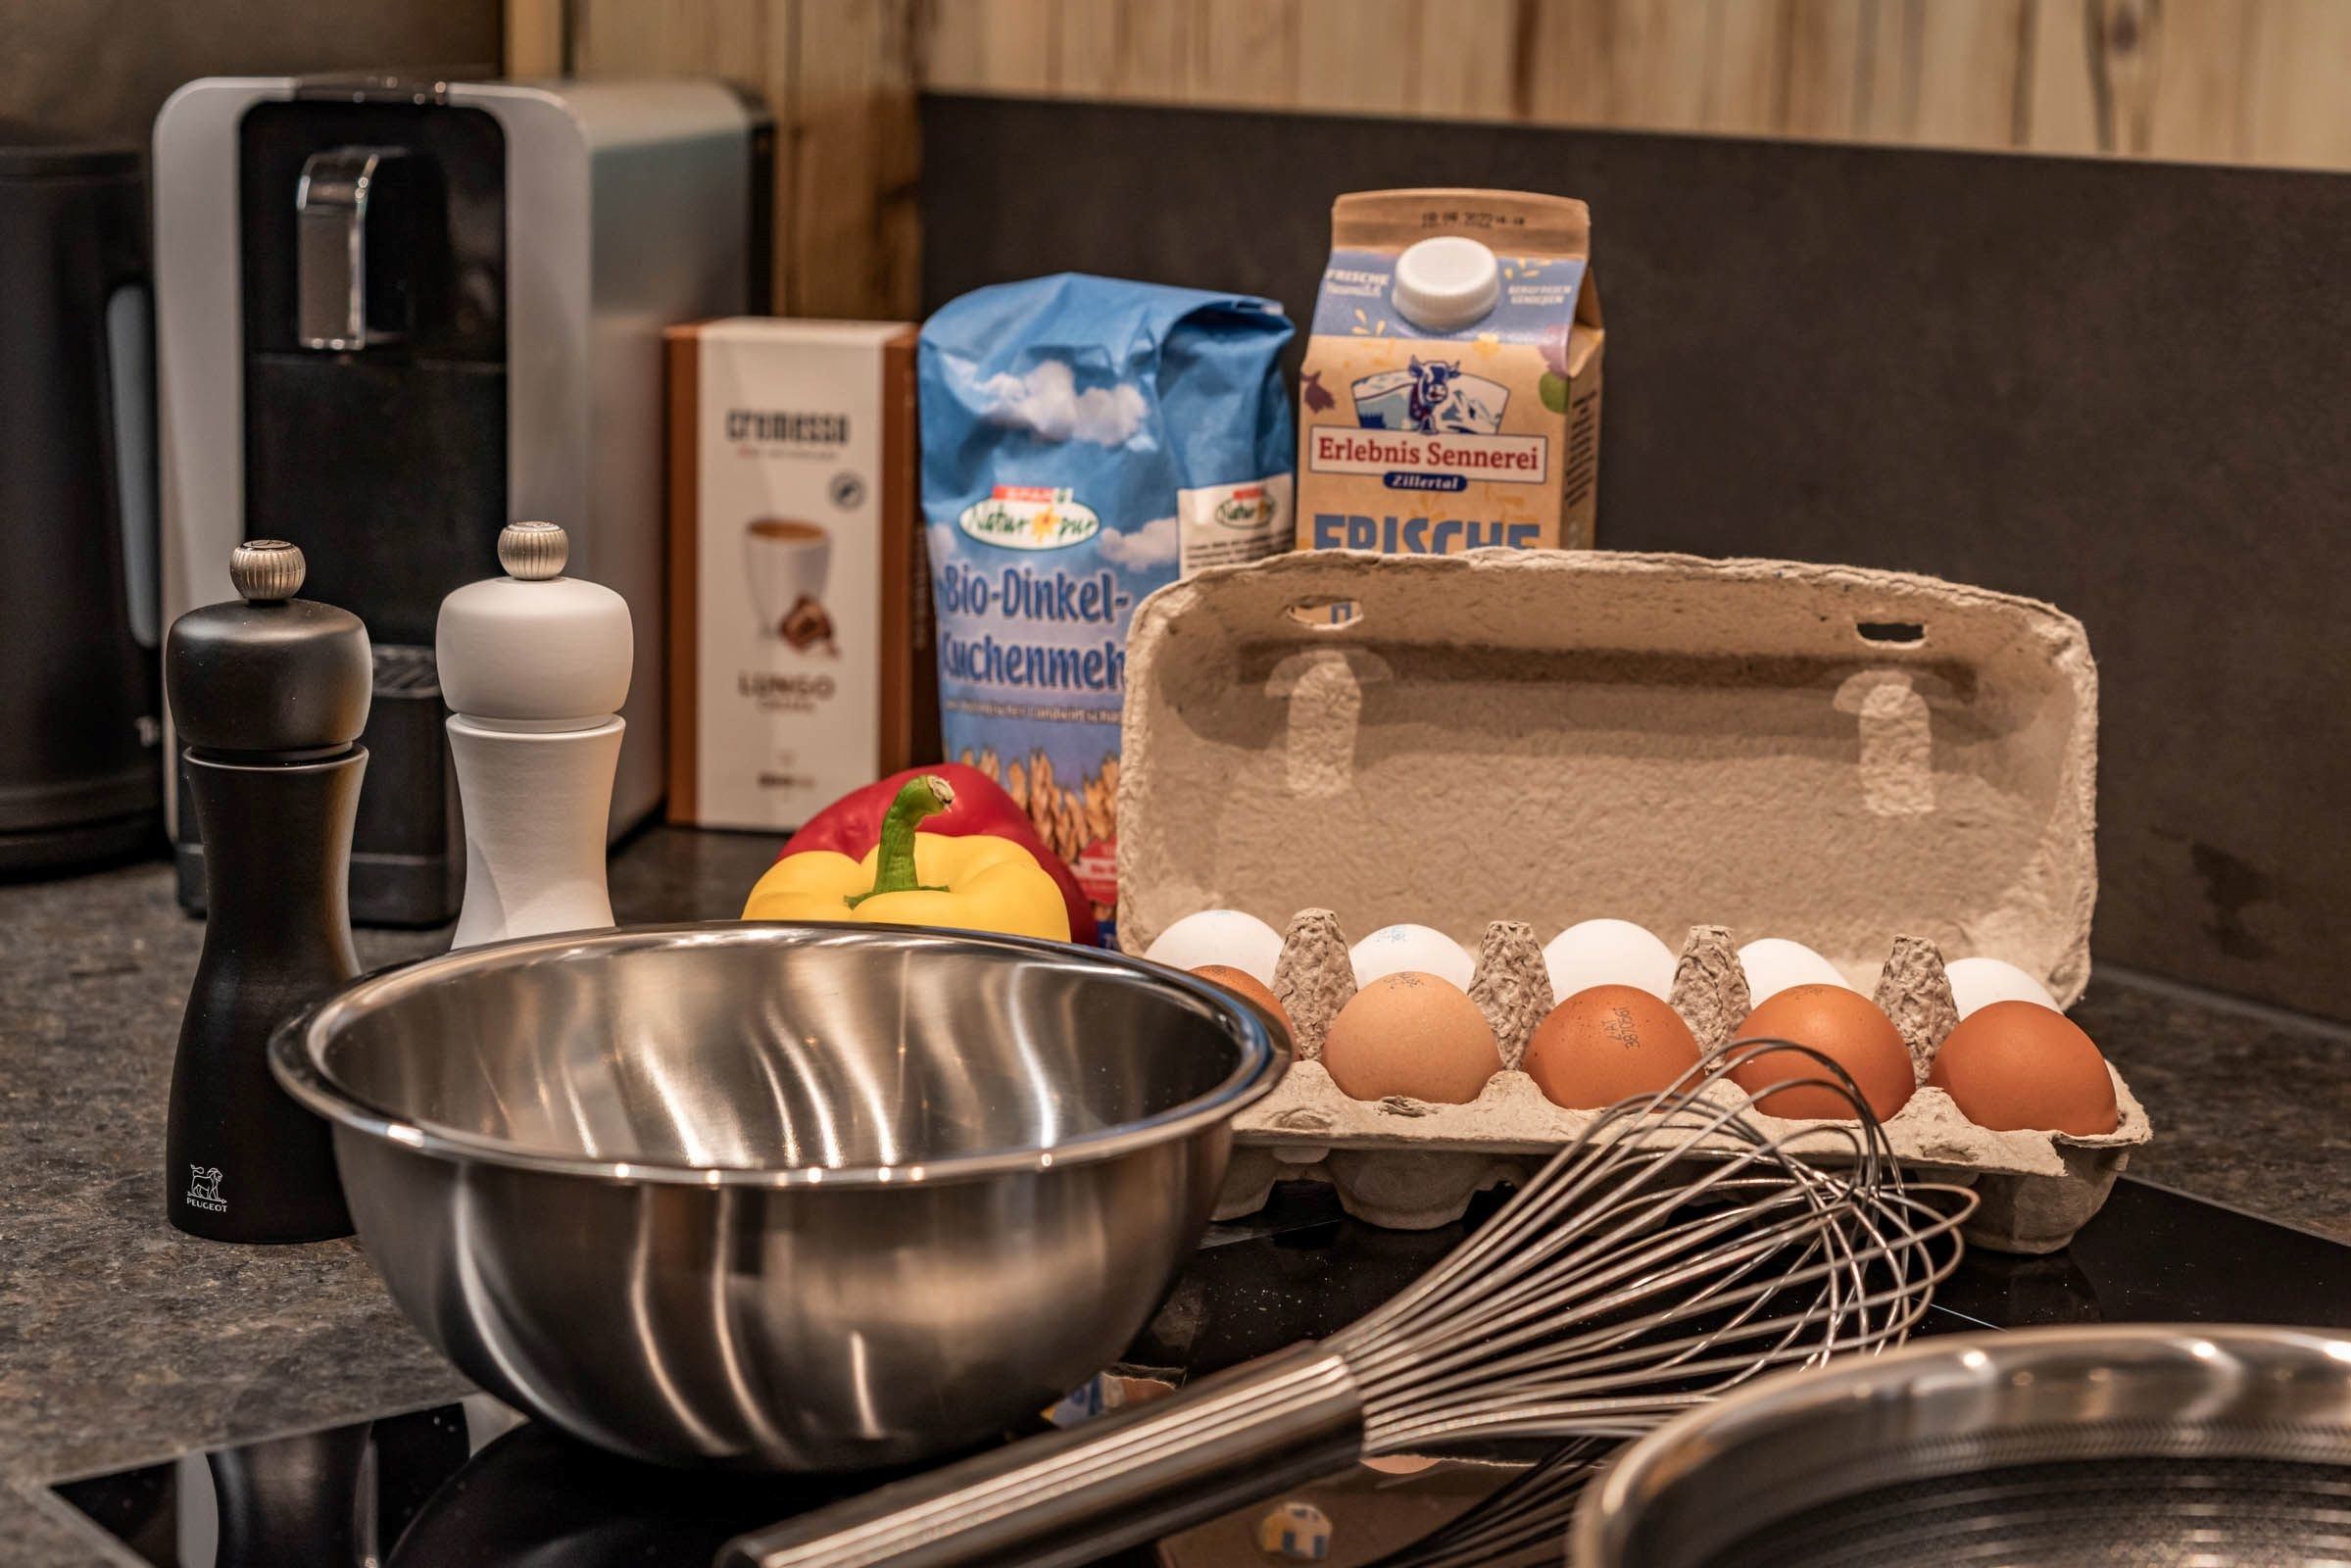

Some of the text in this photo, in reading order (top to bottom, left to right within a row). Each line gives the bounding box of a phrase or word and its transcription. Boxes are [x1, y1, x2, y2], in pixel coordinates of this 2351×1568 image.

[1318, 437, 1539, 470] Erlebnis Sennerei
[1392, 473, 1459, 490] Zillertal
[943, 564, 1128, 622] Bio-Dinkel-
[186, 1197, 228, 1213] PEUGEOT
